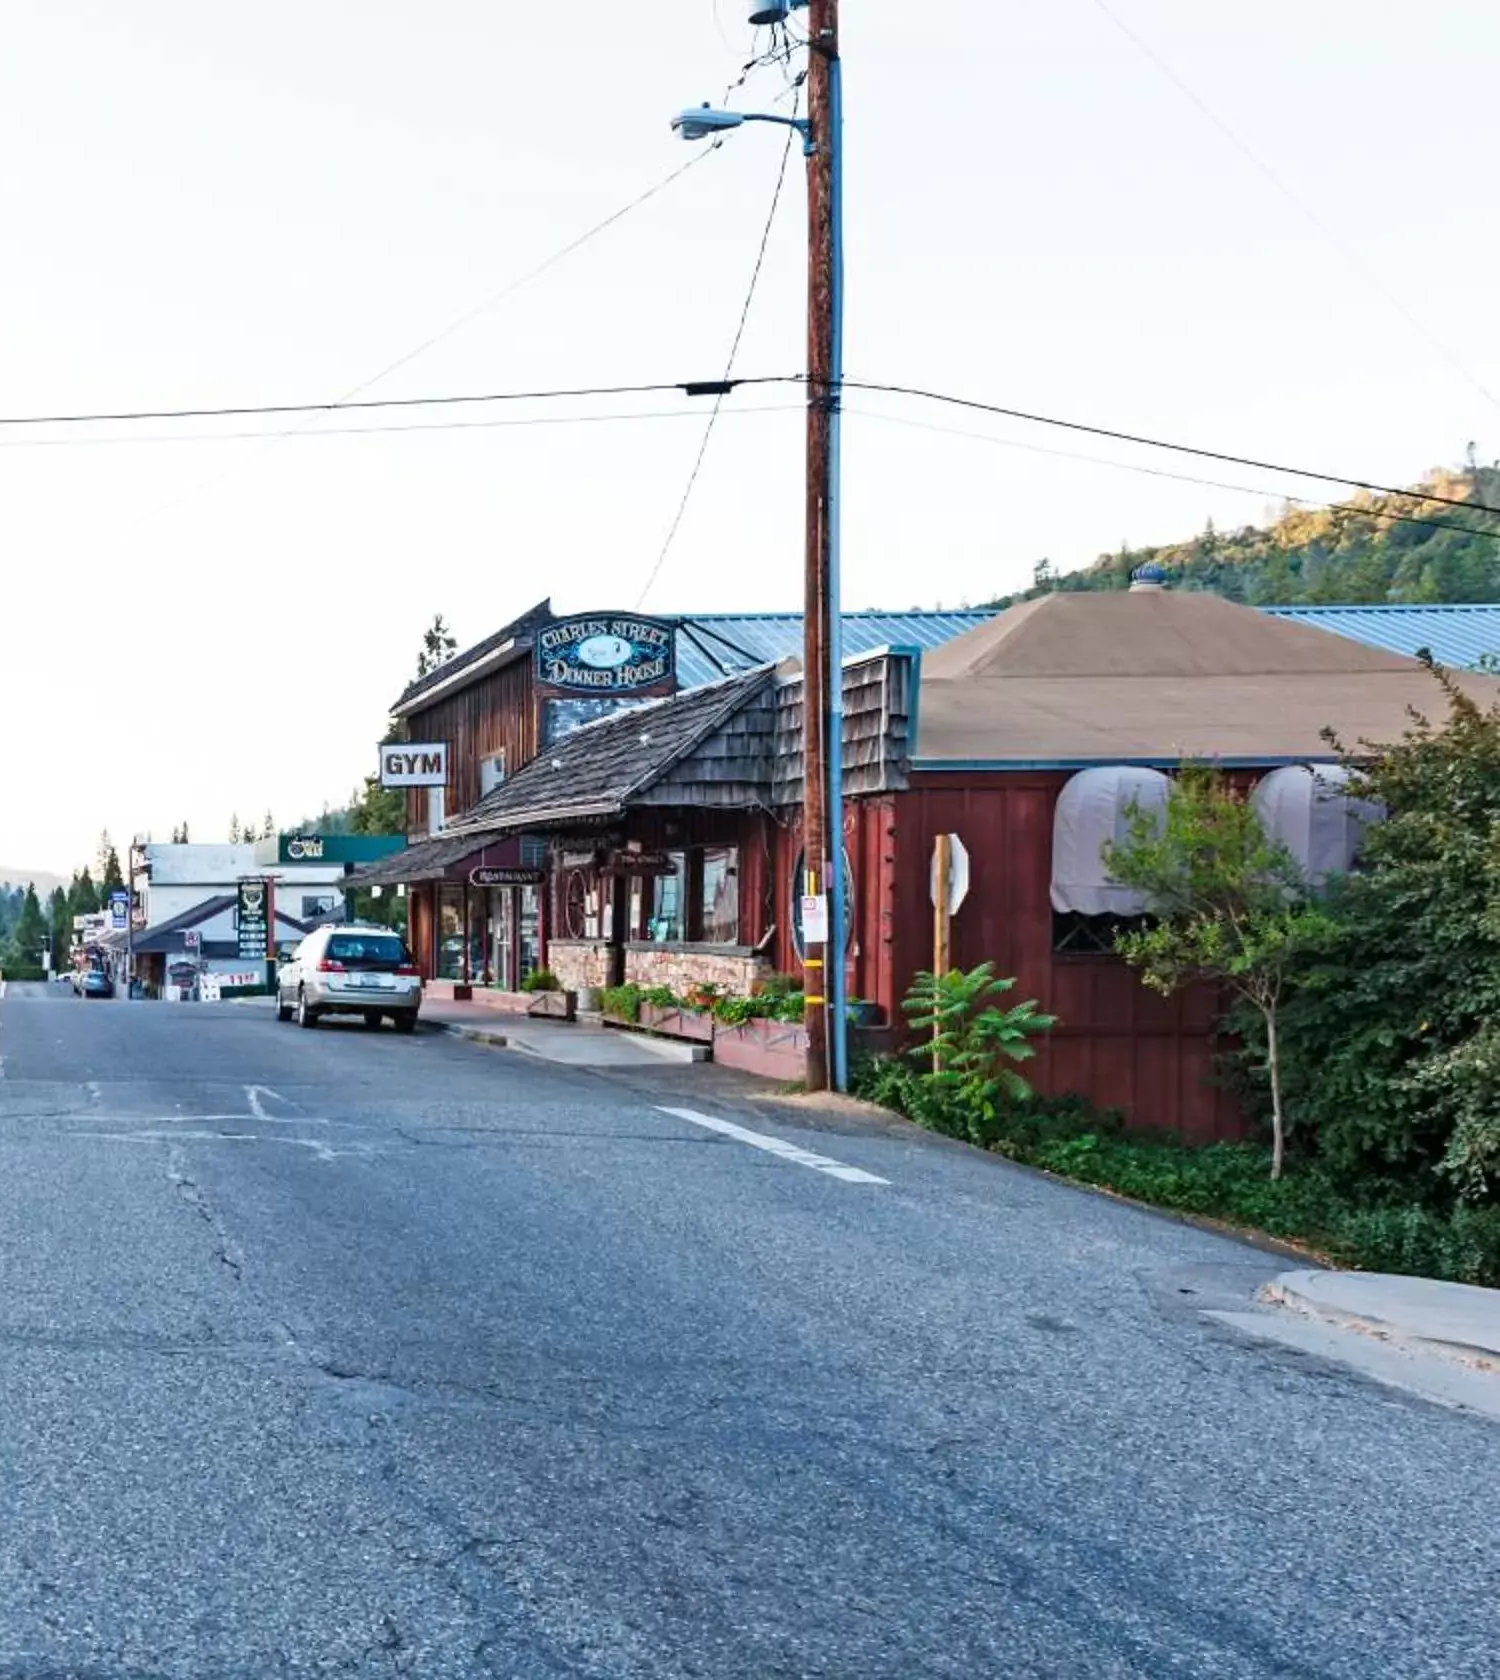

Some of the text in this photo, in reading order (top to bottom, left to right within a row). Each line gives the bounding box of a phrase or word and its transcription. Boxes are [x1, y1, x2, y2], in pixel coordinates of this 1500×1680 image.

[542, 620, 669, 648] CHARLES STREET
[546, 659, 664, 686] DINNER HOUSE
[386, 752, 441, 774] GYM
